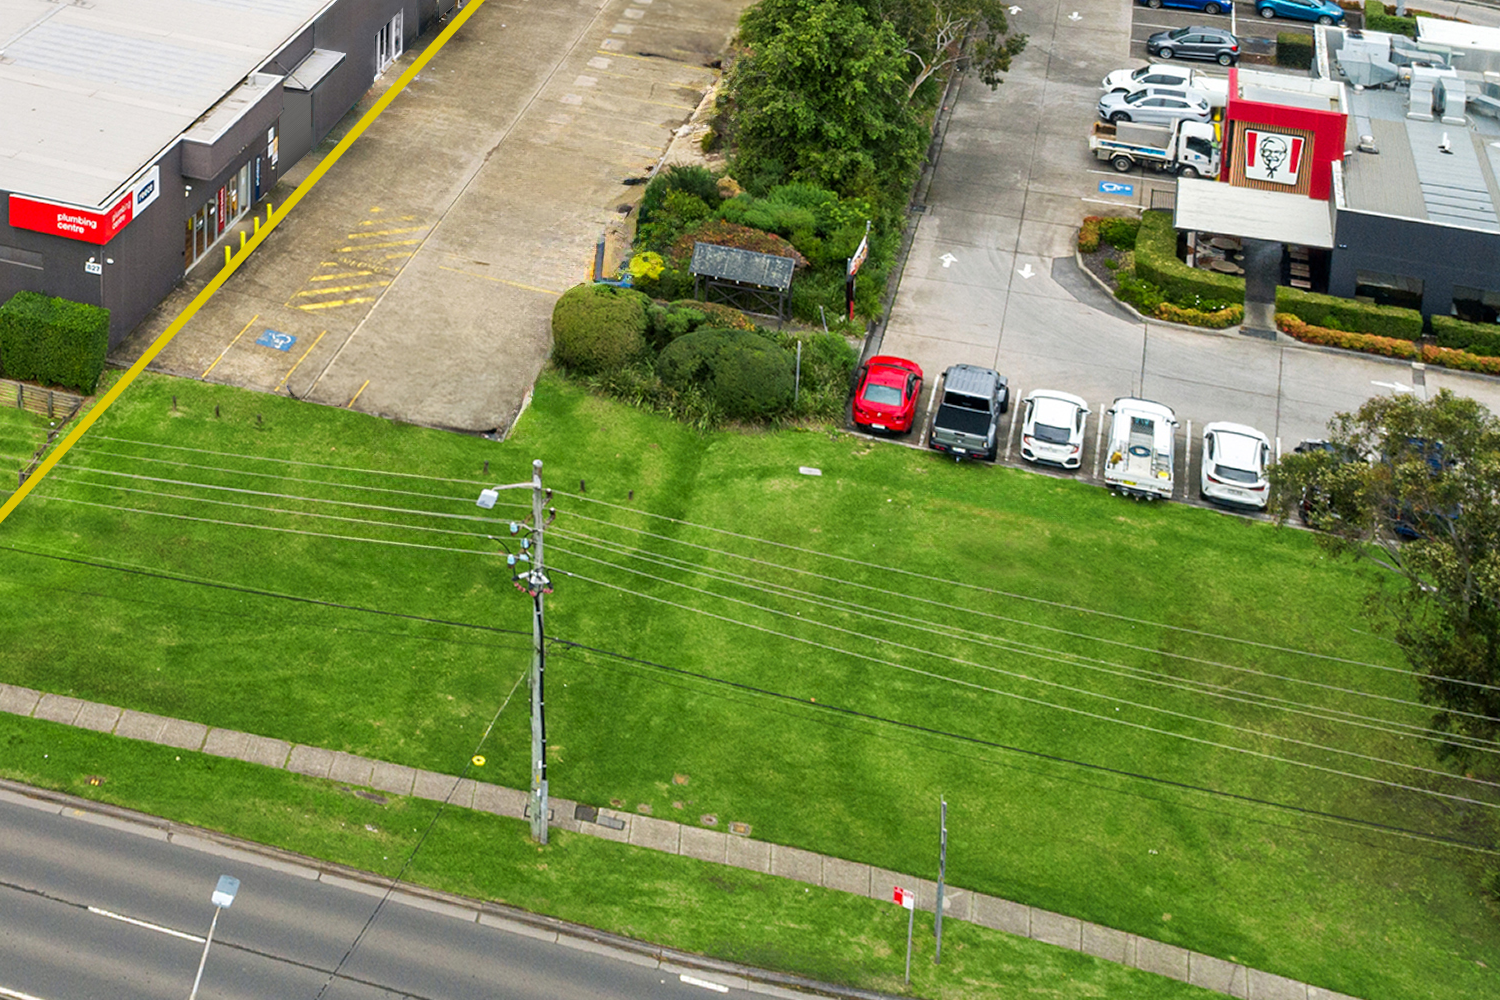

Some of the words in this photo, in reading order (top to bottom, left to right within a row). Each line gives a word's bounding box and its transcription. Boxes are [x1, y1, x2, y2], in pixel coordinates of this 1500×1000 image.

[112, 200, 132, 223] plumbing
[57, 213, 98, 230] plumbing
[57, 221, 85, 234] centre
